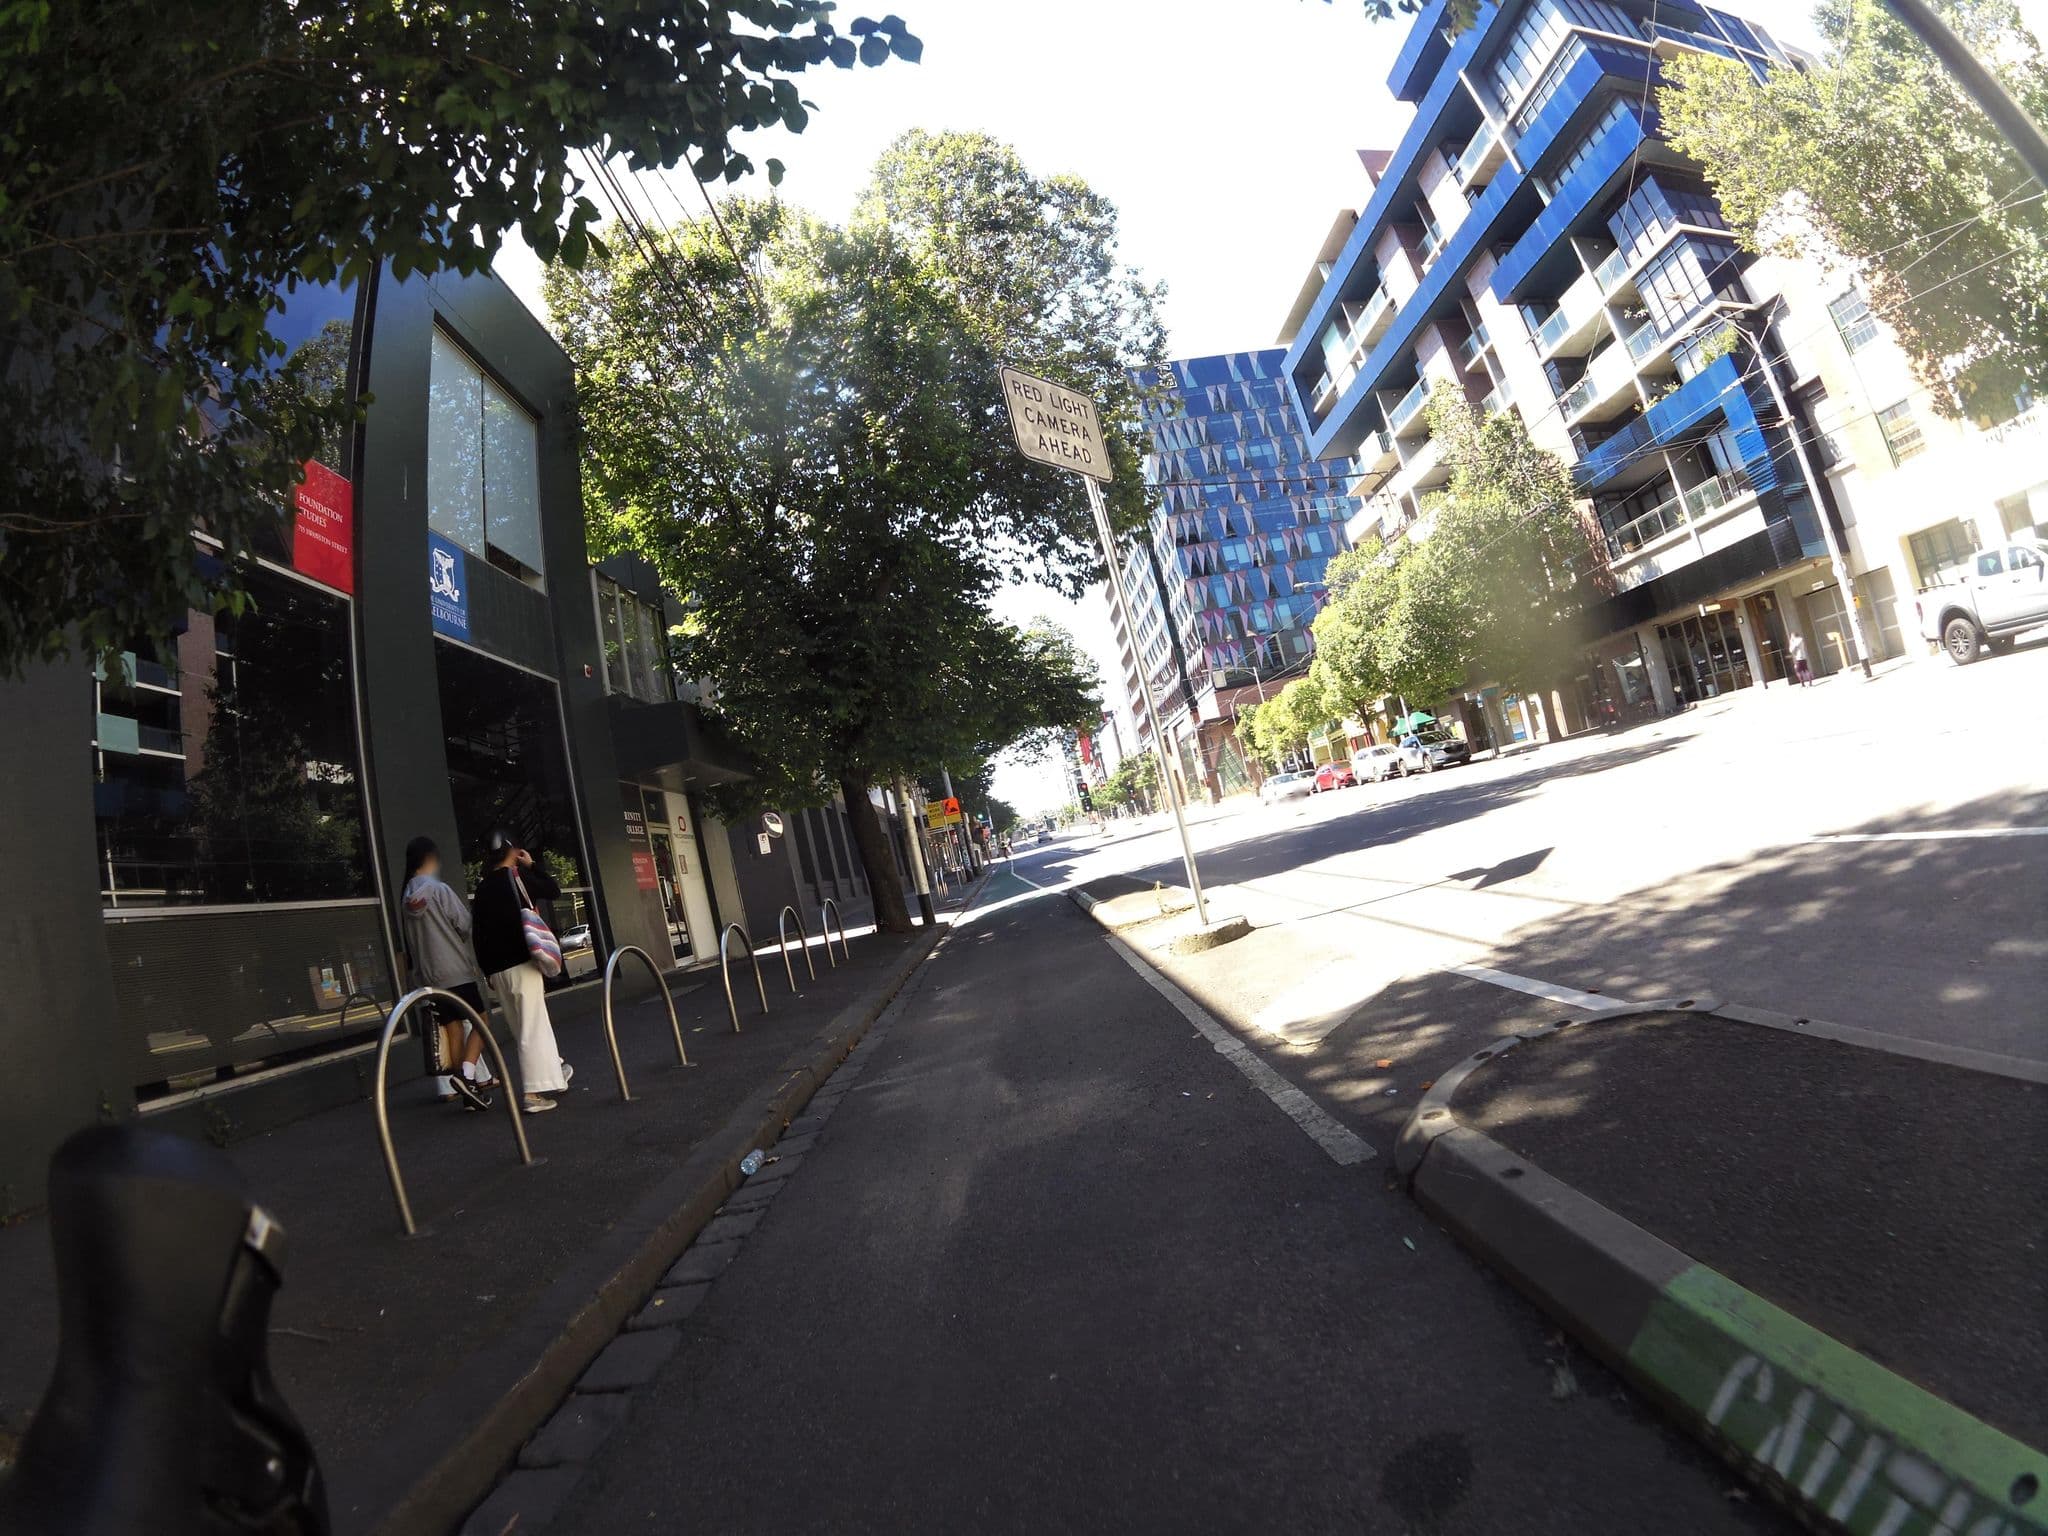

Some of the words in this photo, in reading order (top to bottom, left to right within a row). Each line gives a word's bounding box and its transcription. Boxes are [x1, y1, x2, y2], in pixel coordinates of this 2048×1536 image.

[1012, 380, 1042, 403] RED
[1049, 392, 1089, 419] LIGHT
[1024, 407, 1092, 442] CAMERA
[1038, 433, 1092, 464] AHEAD
[299, 492, 343, 523] FOUNDATION
